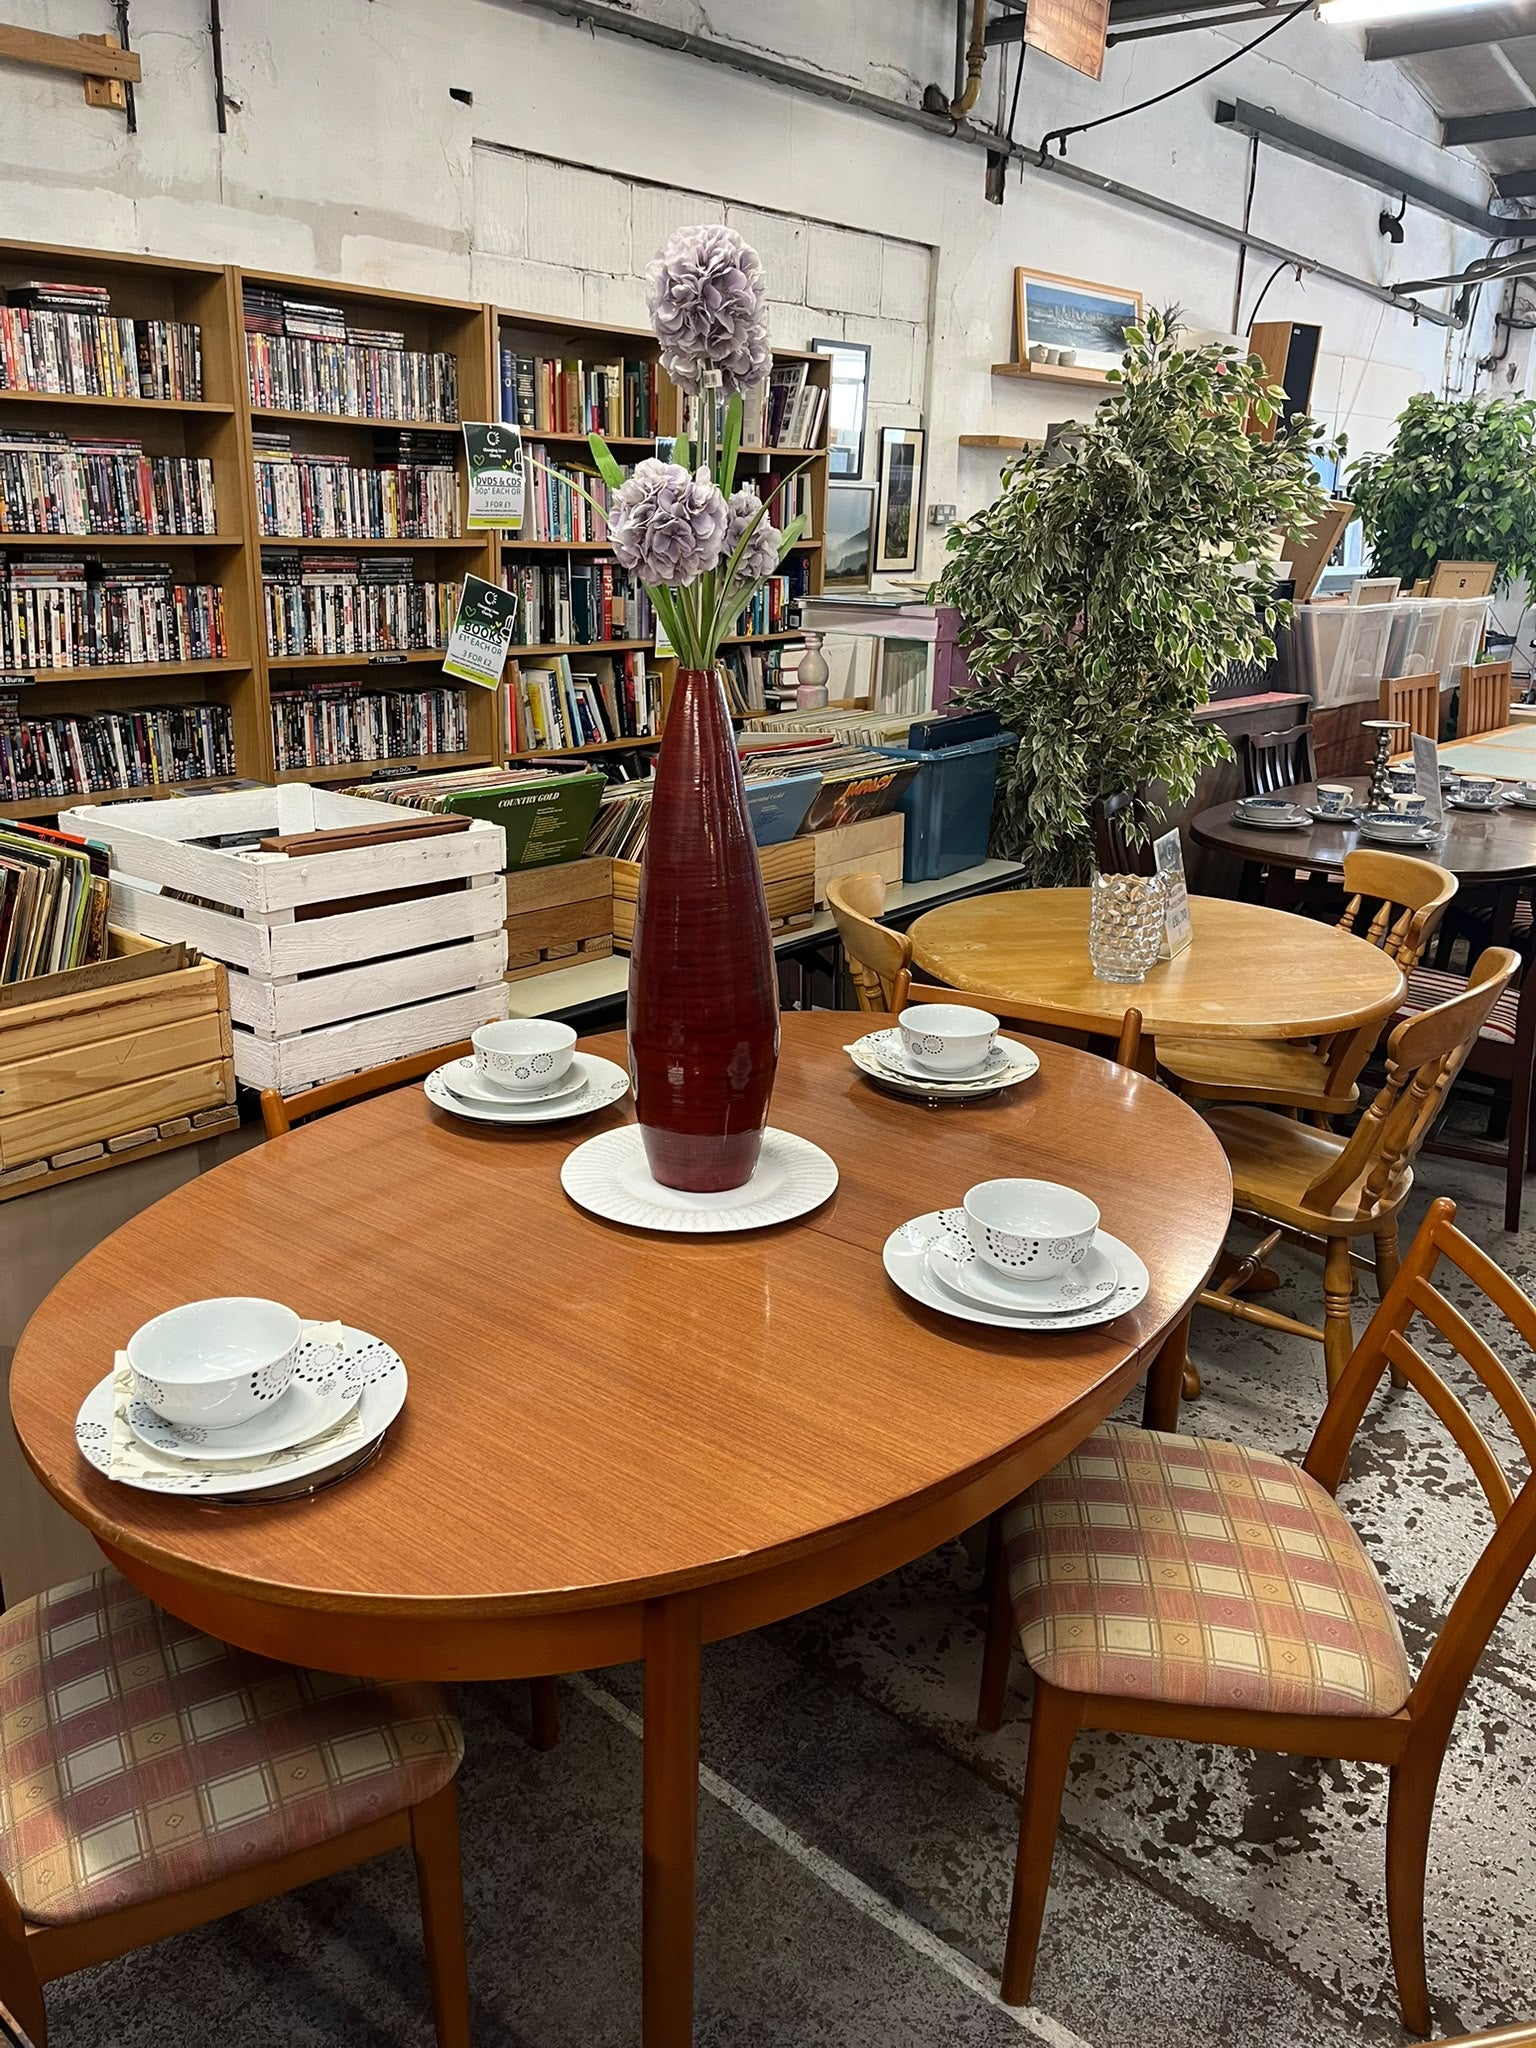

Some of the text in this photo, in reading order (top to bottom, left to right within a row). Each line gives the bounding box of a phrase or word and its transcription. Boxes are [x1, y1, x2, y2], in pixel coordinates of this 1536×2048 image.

[476, 477, 522, 486] DVDS & CDS
[511, 488, 521, 496] OR
[463, 620, 503, 645] BOOKS
[471, 638, 491, 651] EACH
[491, 646, 503, 656] OR
[462, 650, 492, 667] 3 FOR £2
[498, 792, 560, 808] COUNTRY GOLD
